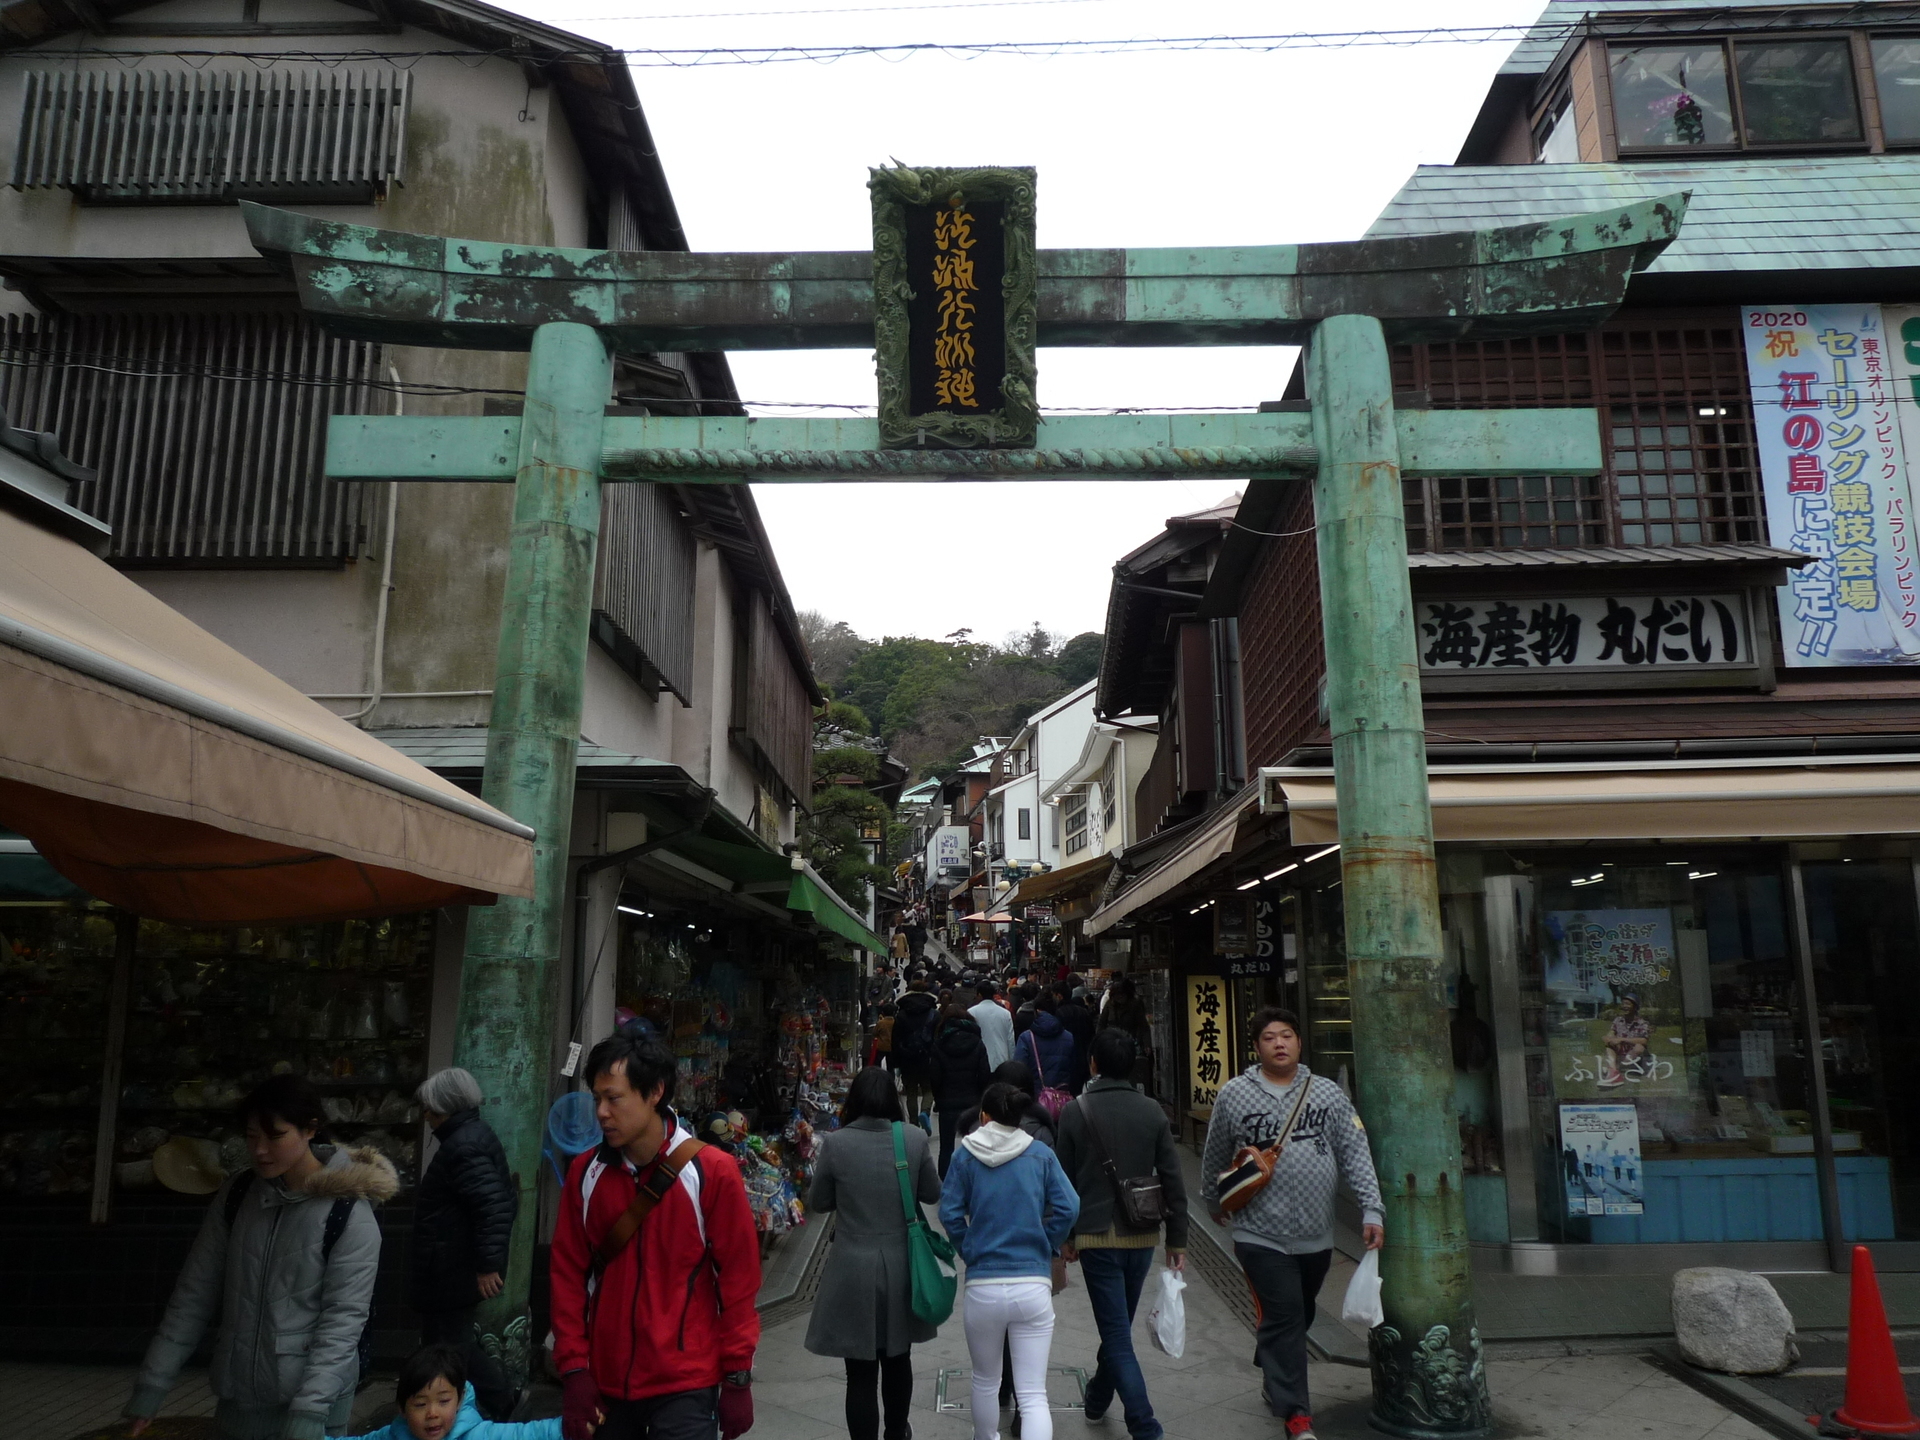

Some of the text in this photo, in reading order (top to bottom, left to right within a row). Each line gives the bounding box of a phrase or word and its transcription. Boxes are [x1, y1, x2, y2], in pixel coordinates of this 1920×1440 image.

[1749, 312, 1808, 328] 2020
[1765, 329, 1799, 358] 祝
[1818, 328, 1880, 613] セーリング競技会場
[1861, 338, 1918, 629] 東京オリンピック・パラリンピック
[1421, 597, 1738, 668] 海産物 丸だい
[1230, 961, 1271, 975] 丸だい
[1195, 981, 1222, 1085] 海産物
[1564, 1053, 1674, 1084] ふじさわ
